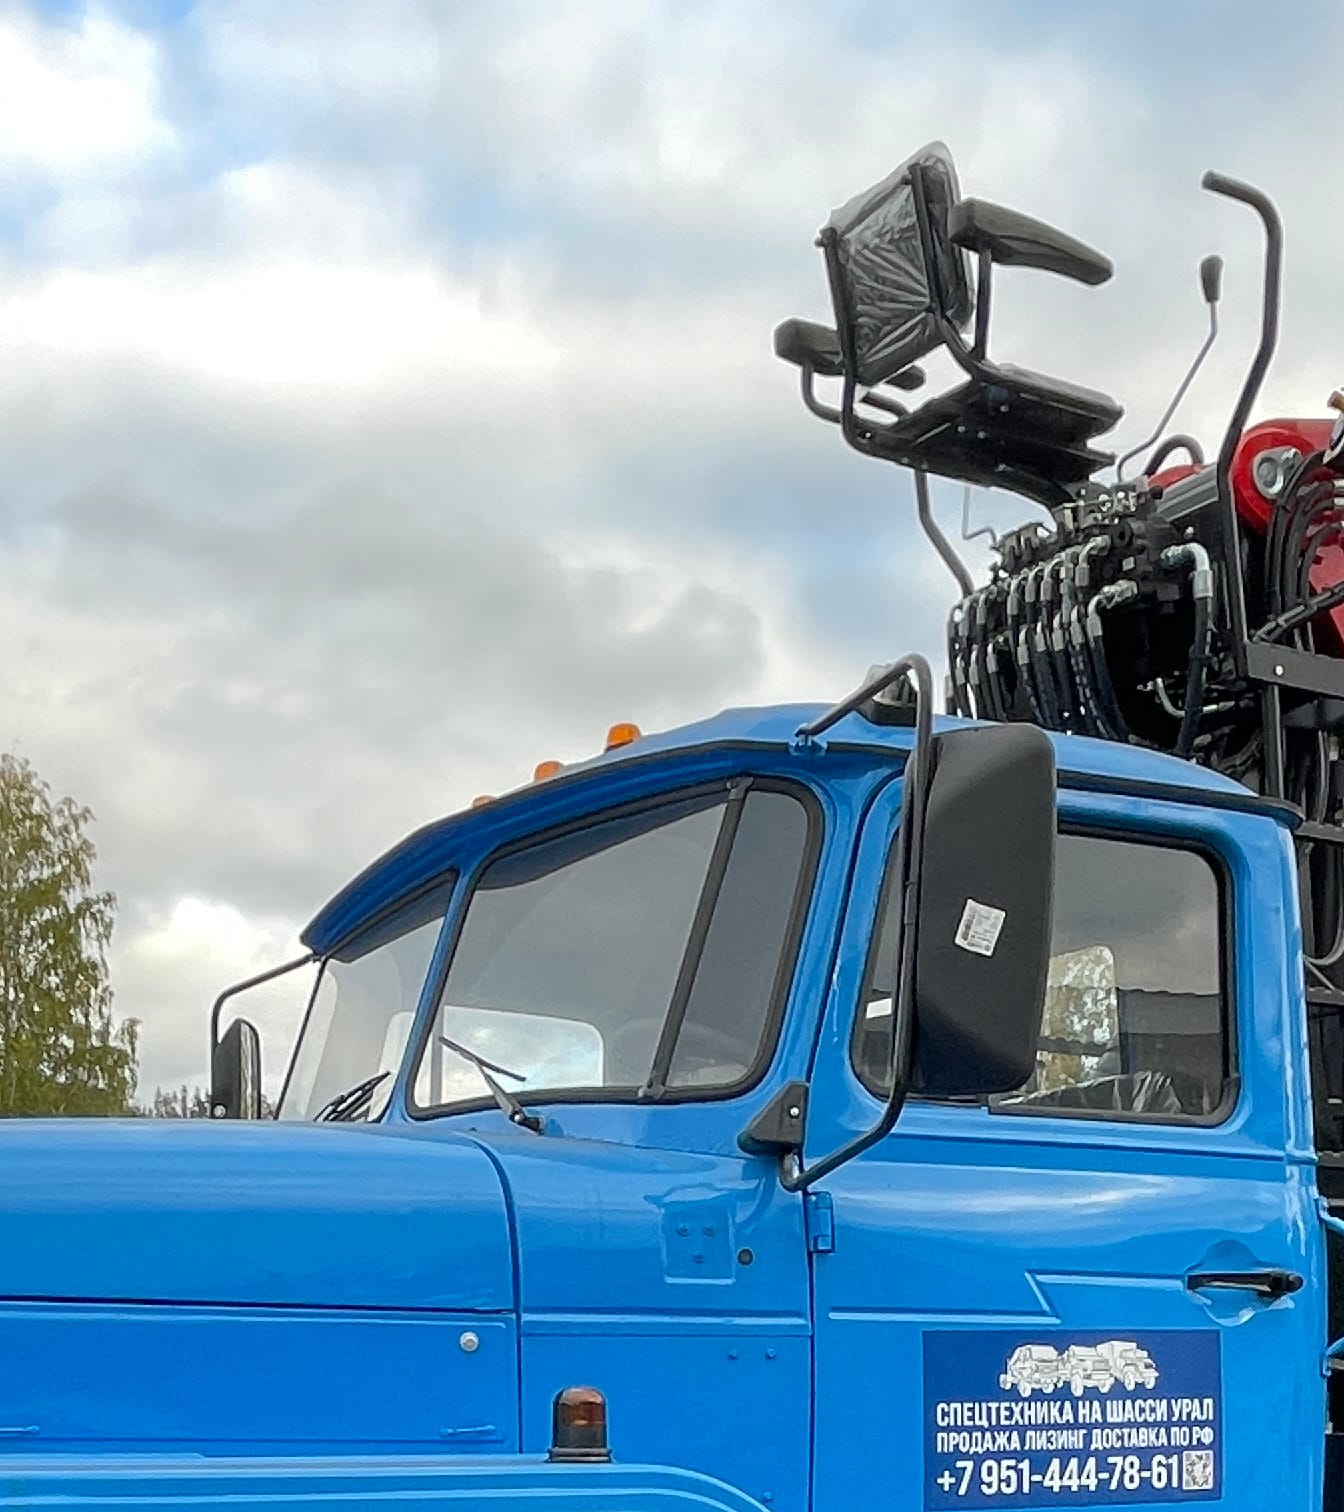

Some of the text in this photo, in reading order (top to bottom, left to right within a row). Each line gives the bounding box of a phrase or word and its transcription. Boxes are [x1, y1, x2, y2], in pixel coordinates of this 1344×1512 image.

[937, 1398, 1213, 1428] СПЕЦТЕХНИКА НА ШАССИ УРАЛ
[937, 1426, 1214, 1454] ПРОДАЖА ЛИЗИНГ ДОСТАВКА ПО РФ
[937, 1454, 1178, 1496] +7 951-444-78-61
